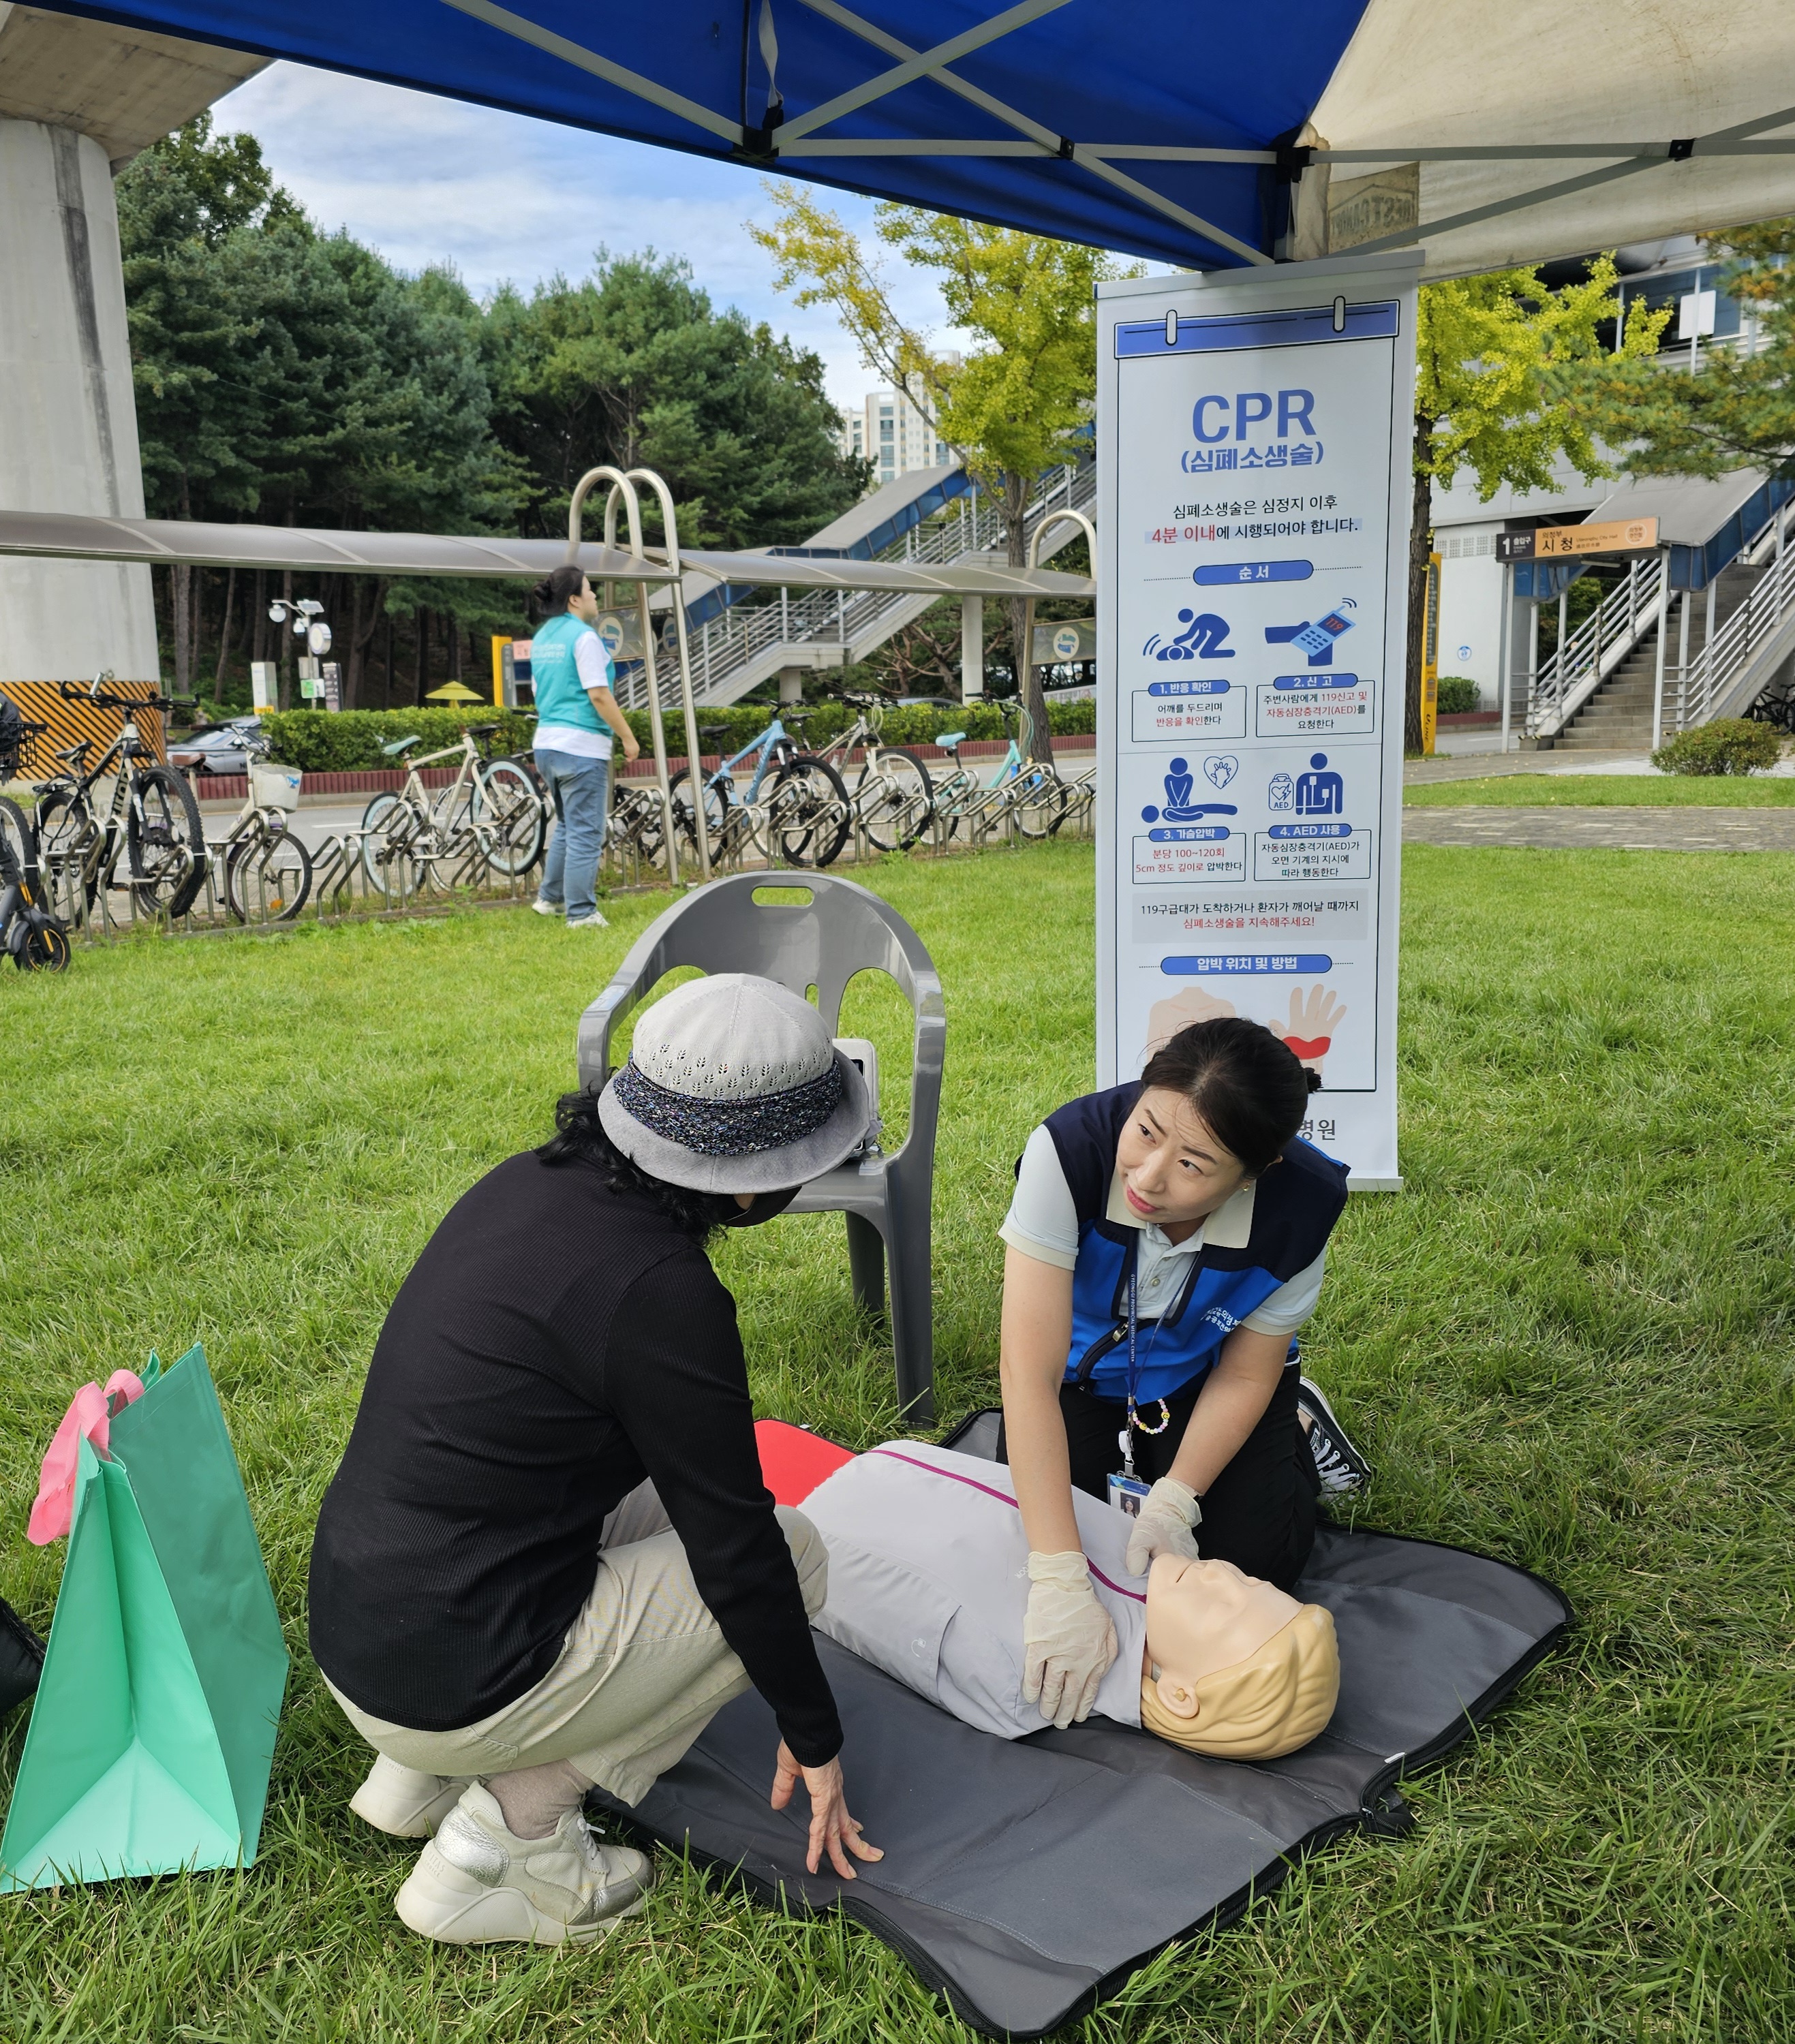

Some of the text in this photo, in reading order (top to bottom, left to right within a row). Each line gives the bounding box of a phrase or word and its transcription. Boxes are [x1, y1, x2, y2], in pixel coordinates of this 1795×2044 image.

[1193, 388, 1317, 444] CPR
[1181, 441, 1323, 474] (심폐소생술)
[1173, 495, 1338, 519] 심폐소생술은 심정지 이후
[1152, 518, 1358, 544] 4분 이내에 시행되어야 합니다.
[1503, 538, 1510, 555] 1
[1325, 617, 1344, 632] 119
[1160, 681, 1212, 694] 1. 반응 확인
[1293, 677, 1304, 687] 2.
[1263, 691, 1367, 704] 주변사람에게 119신고 및
[1158, 702, 1223, 713] 어깨를 두드리며
[1267, 704, 1366, 718] 자동심장충격기(AED)를
[1156, 715, 1221, 727] 반응을 확인한다
[1298, 719, 1334, 730] 요청한다
[1274, 801, 1289, 809] AED
[1177, 828, 1216, 839] 가슴압박
[1280, 824, 1340, 836] 4. AED 사용
[1153, 847, 1225, 859] 분당 100~120회
[1261, 841, 1360, 853] 자동심장충격기(AED)가
[1272, 854, 1349, 865] 오면 기계의 지시에
[1135, 862, 1242, 873] 5cm 정도 깊이로 압박한다
[1282, 867, 1338, 878] 따라 행동한다
[1141, 900, 1359, 915] 119구급대가 도착하거나 환자가 깨어날 때까지
[1184, 916, 1315, 929] 심폐소생술을 지속해주세요!
[1197, 957, 1298, 971] 압박 위치 및 방법
